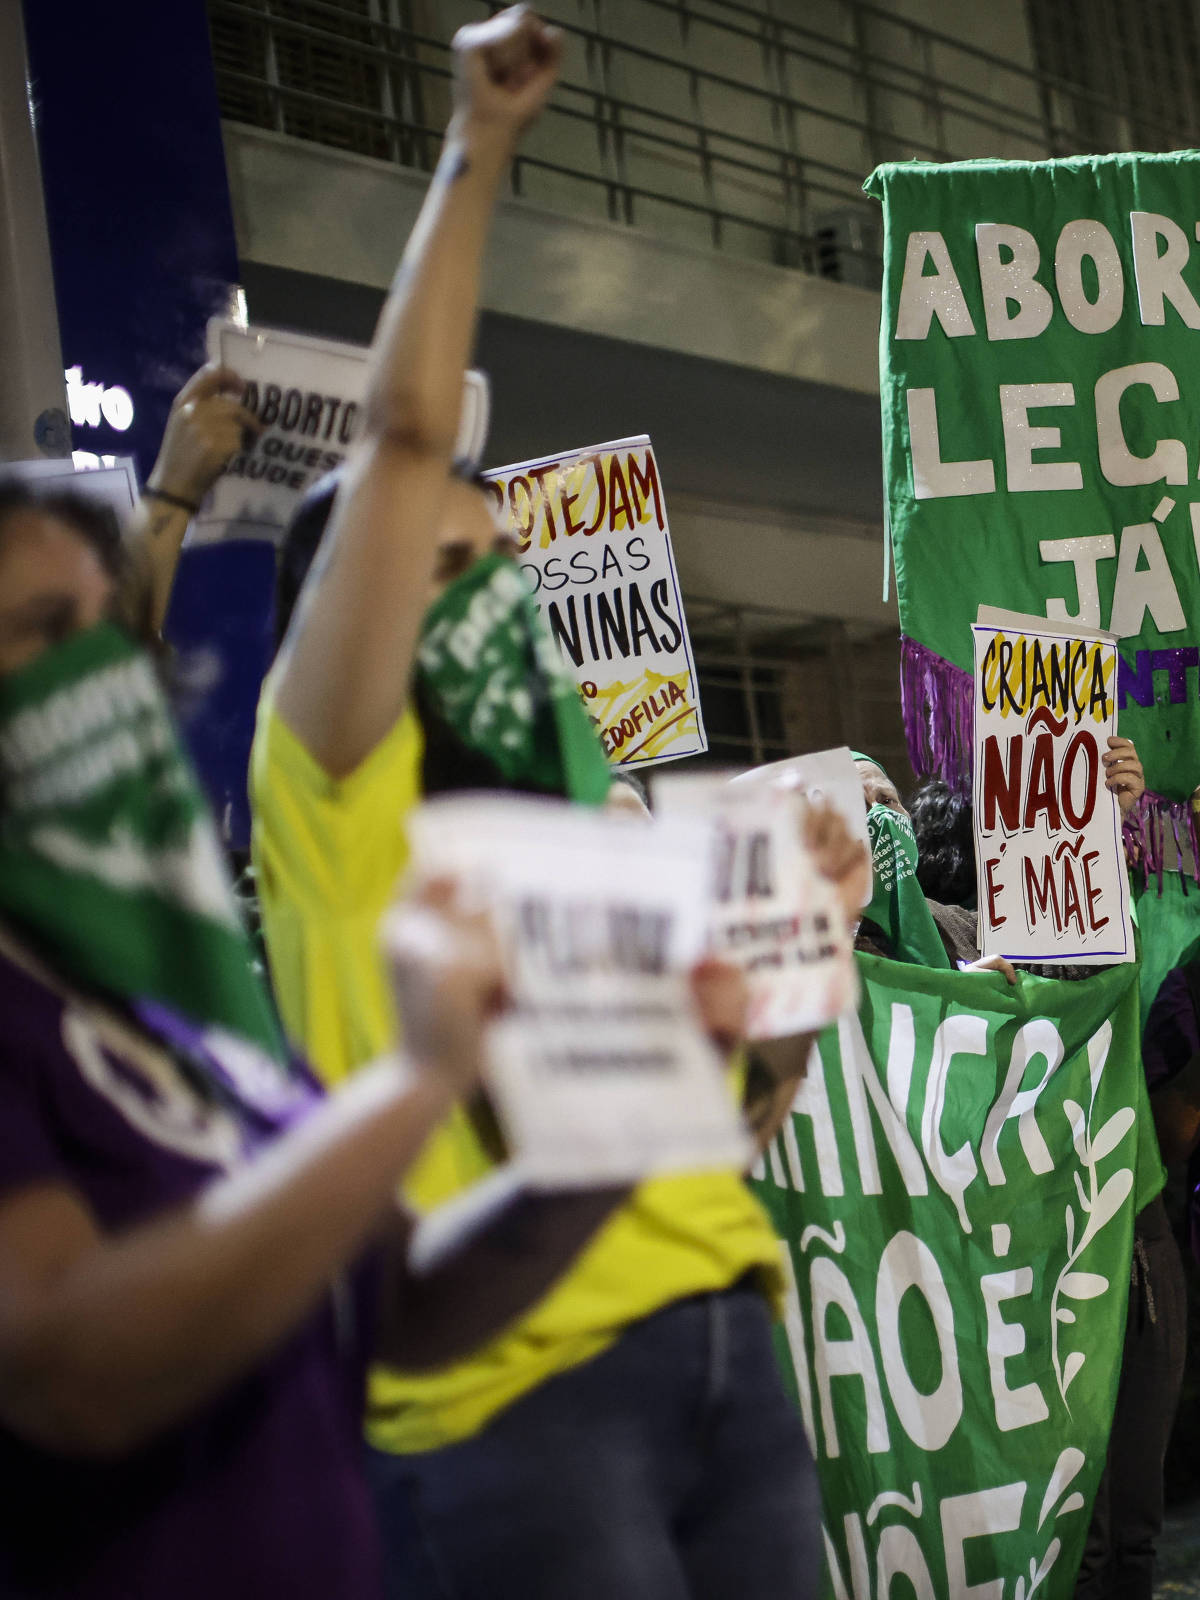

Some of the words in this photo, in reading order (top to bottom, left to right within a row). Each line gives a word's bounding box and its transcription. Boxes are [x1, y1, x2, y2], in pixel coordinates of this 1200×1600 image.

[262, 437, 346, 472] QUES
[535, 578, 682, 668] NINAS
[601, 681, 686, 755] EDOFILIA
[981, 638, 1108, 727] CRIANÇA
[983, 705, 1100, 833] NÃO
[985, 842, 1008, 928] É
[1023, 834, 1110, 936] MÃE
[777, 1220, 964, 1460] ÃO
[980, 1223, 1050, 1432] É
